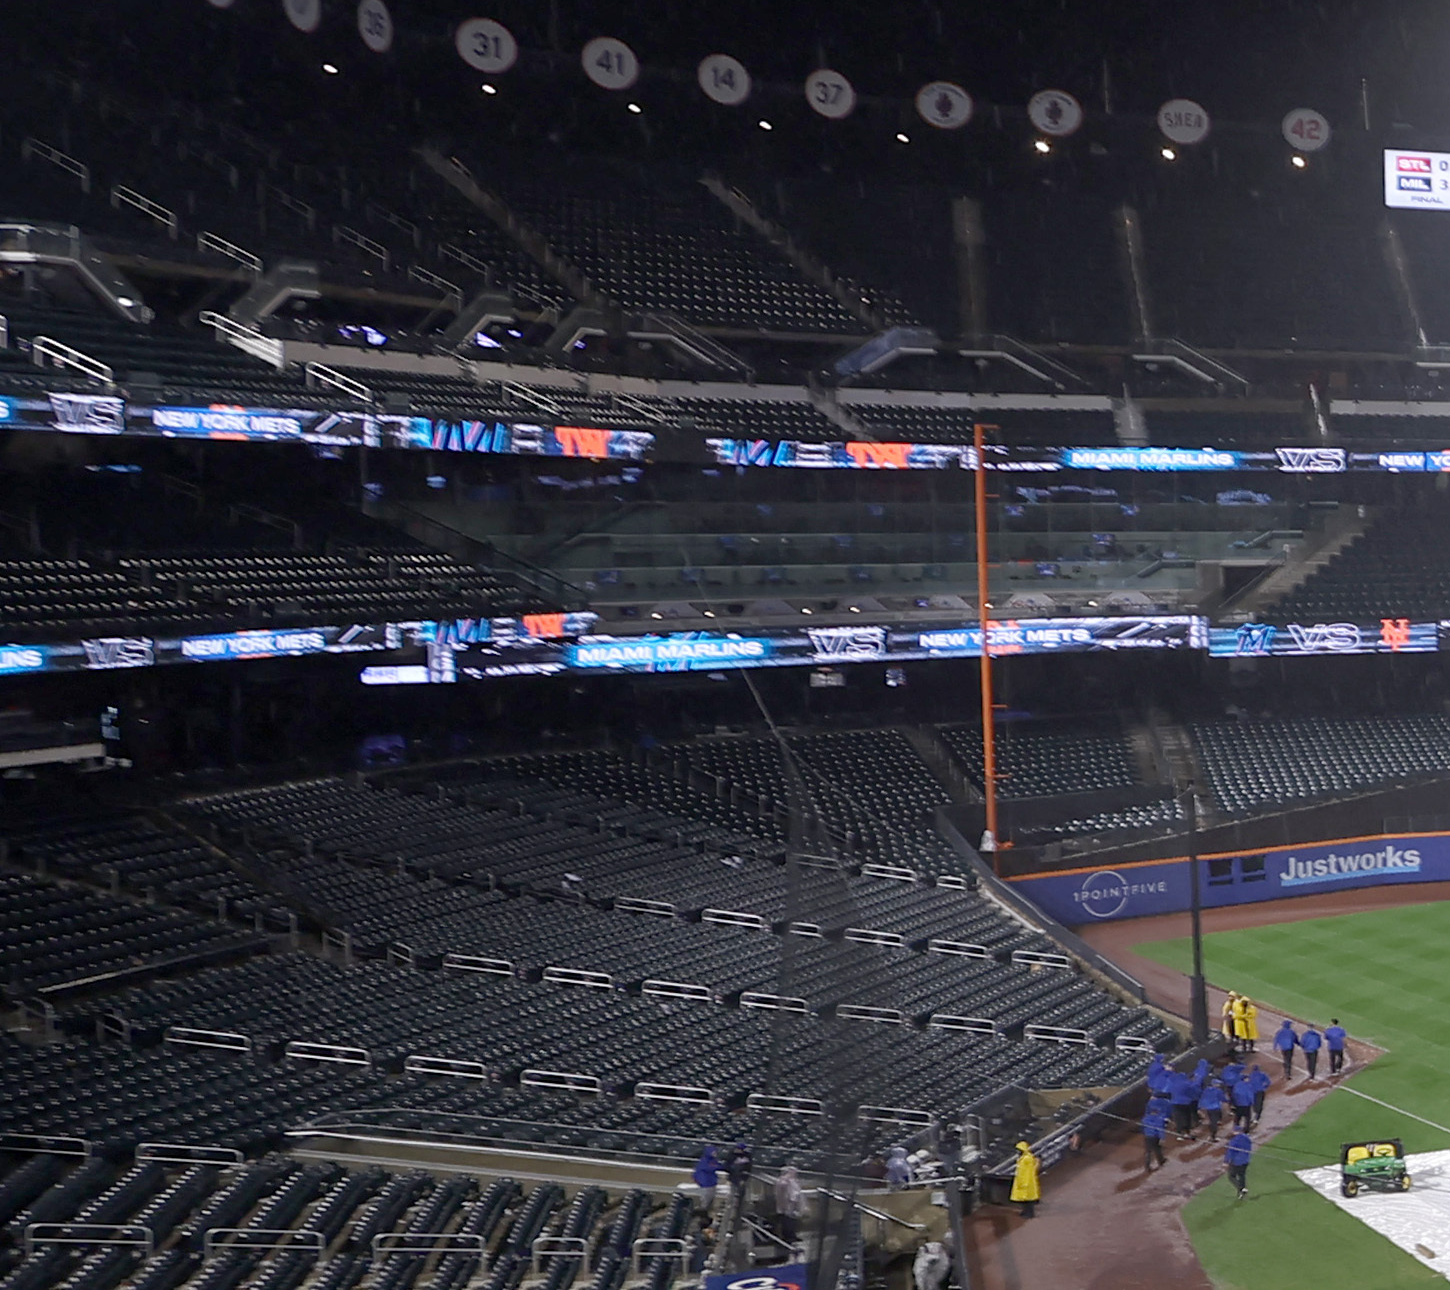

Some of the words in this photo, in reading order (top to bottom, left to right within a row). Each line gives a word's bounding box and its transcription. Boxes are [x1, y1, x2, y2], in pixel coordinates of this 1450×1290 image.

[472, 32, 501, 58] 31
[596, 52, 625, 76] 41
[711, 66, 736, 89] 14
[815, 83, 846, 104] 37
[1290, 117, 1321, 141] 42
[153, 411, 198, 429] NEW
[250, 414, 301, 434] METS
[1072, 451, 1137, 465] MIAMI
[1140, 452, 1235, 466] MARLINS
[1379, 454, 1424, 467] NEW
[1280, 845, 1422, 881] Justworks
